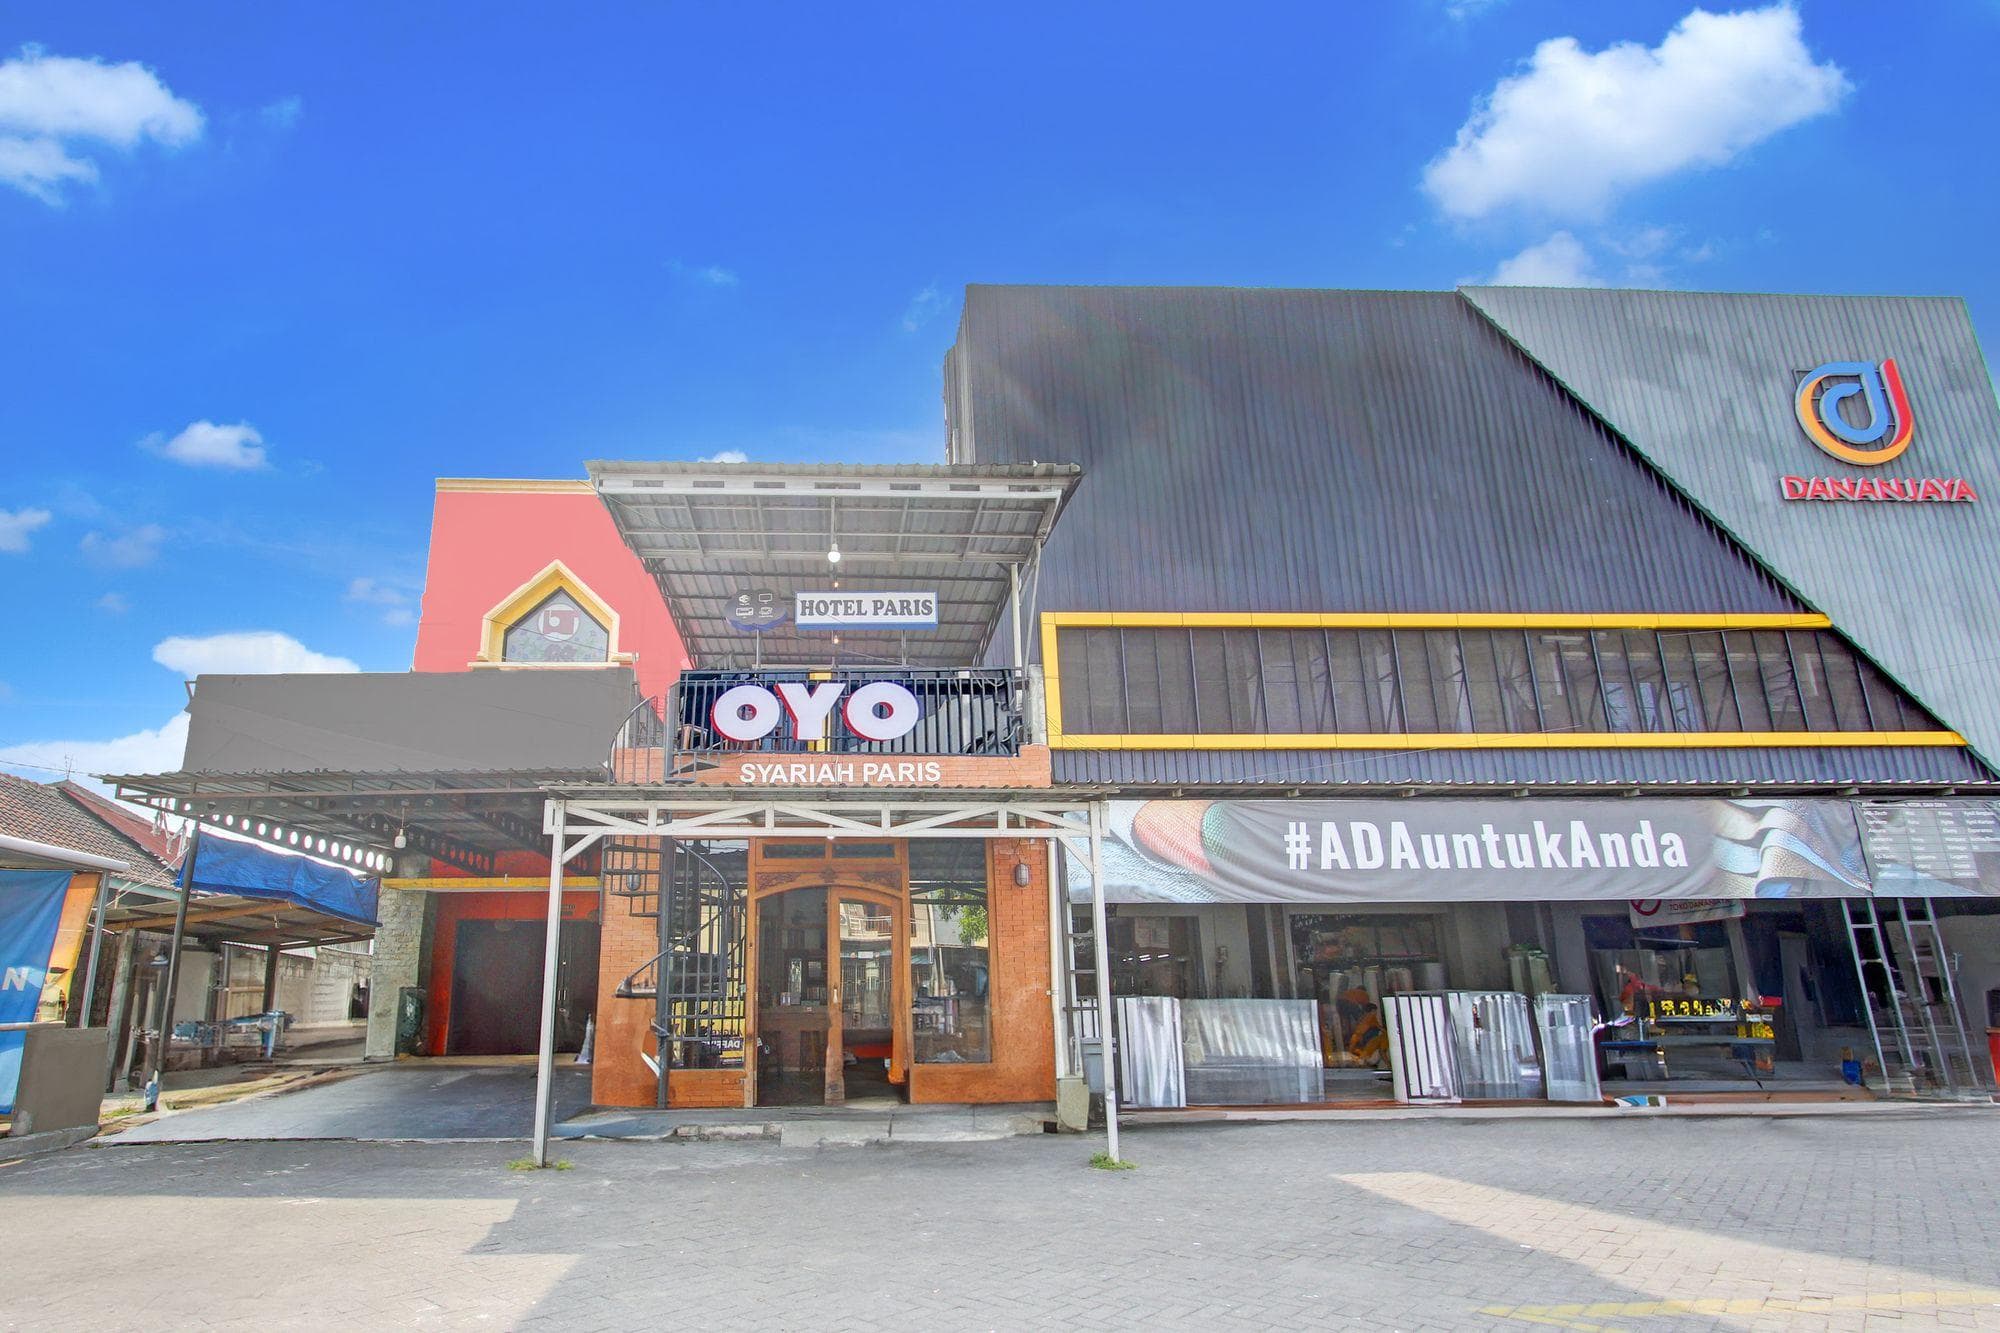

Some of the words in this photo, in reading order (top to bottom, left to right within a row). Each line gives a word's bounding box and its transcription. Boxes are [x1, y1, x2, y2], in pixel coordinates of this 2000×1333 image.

[1779, 475, 1978, 501] DANANJAYA
[800, 599, 867, 616] HOTEL
[872, 599, 933, 616] PARIS
[710, 681, 920, 741] OYO
[739, 763, 854, 783] SYARIAH
[863, 762, 941, 782] PARIS
[1283, 820, 1688, 870] #ADAuntukAnda
